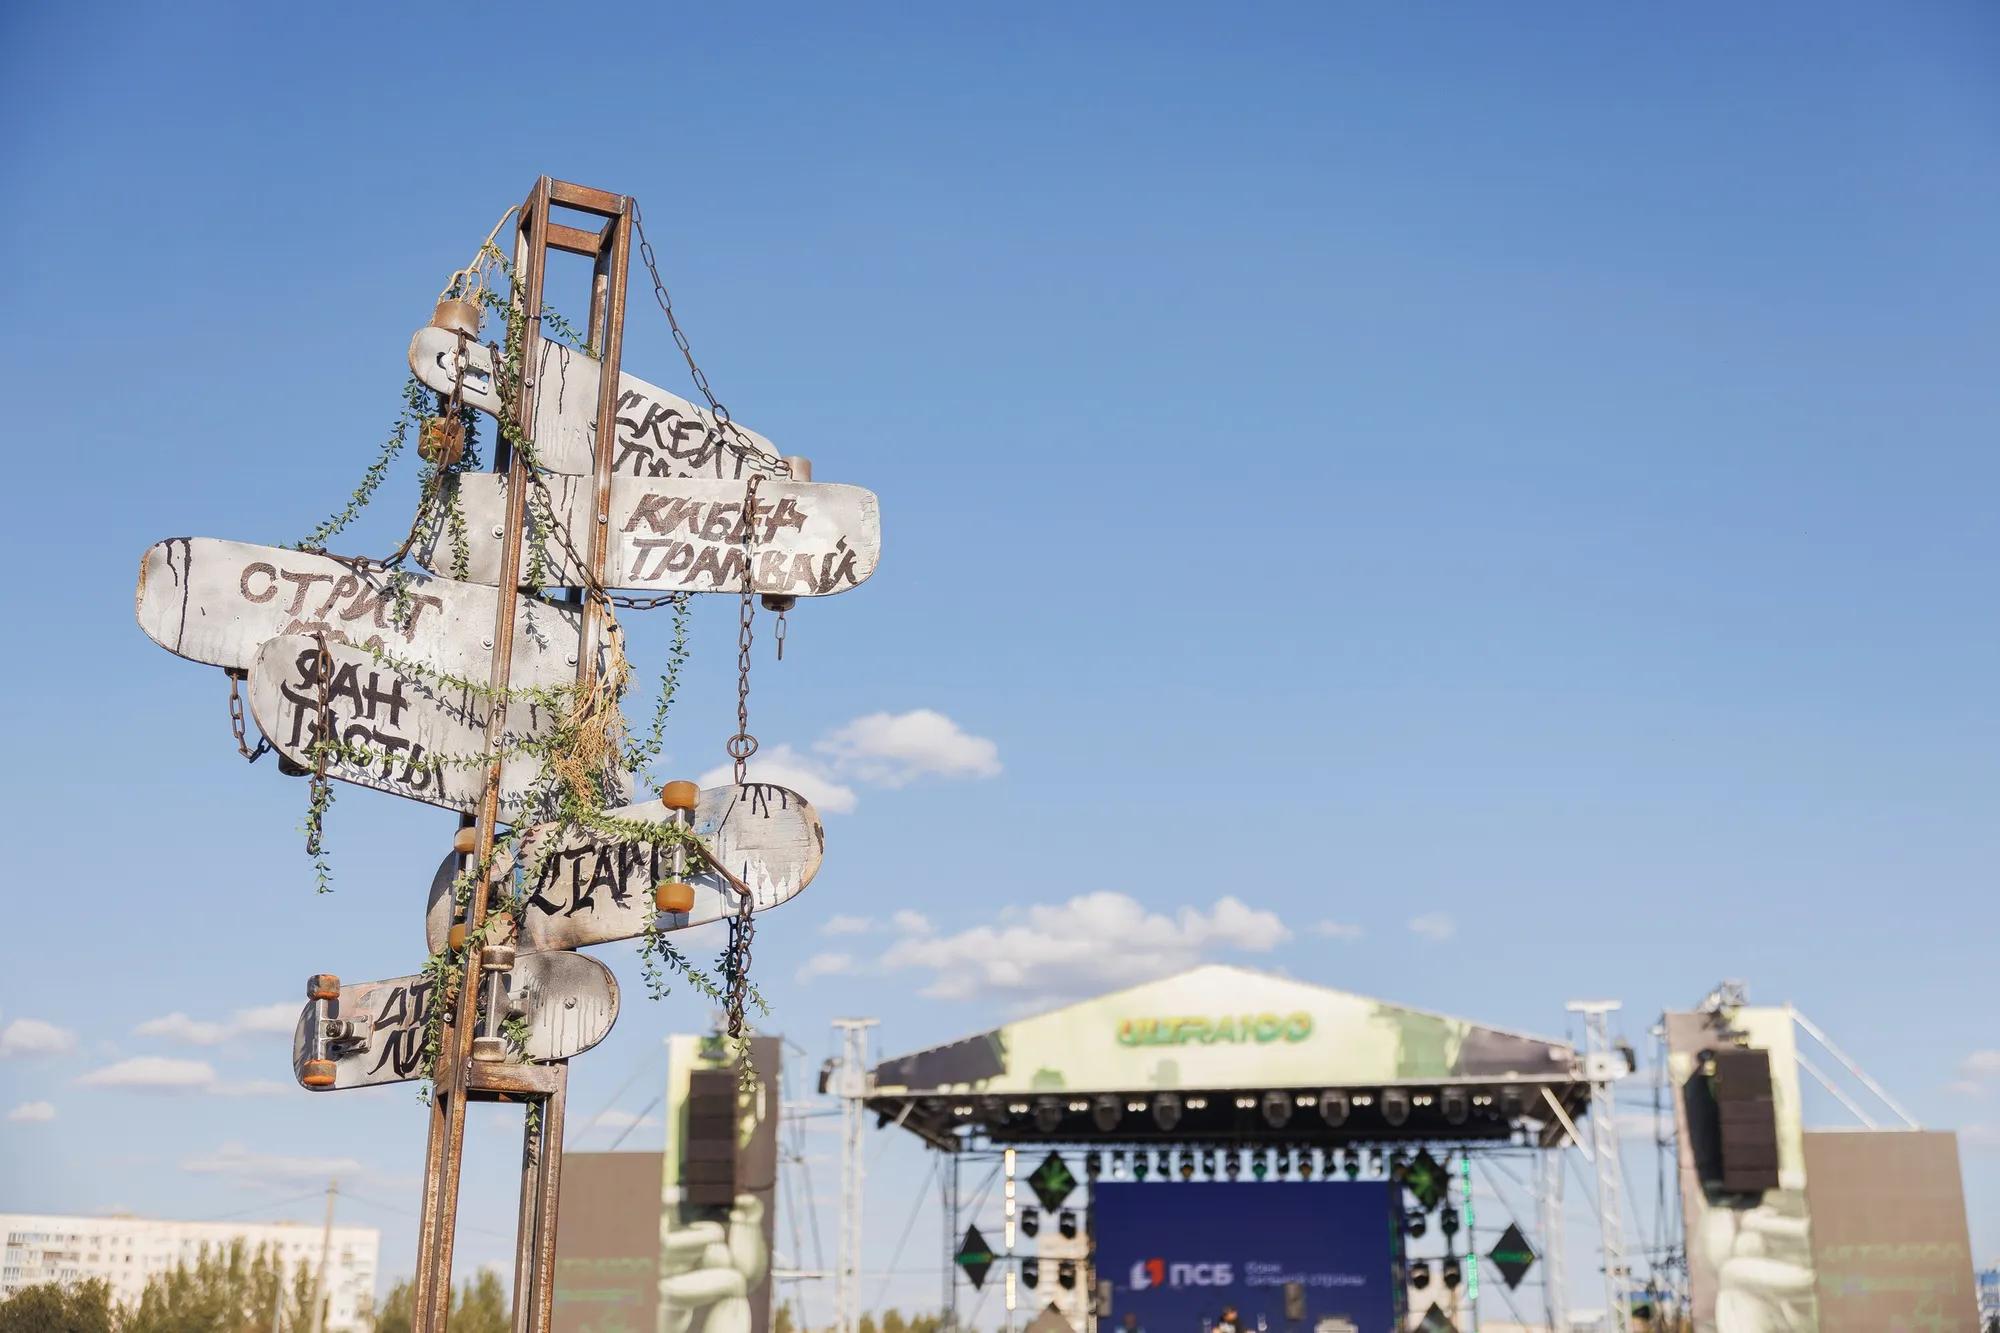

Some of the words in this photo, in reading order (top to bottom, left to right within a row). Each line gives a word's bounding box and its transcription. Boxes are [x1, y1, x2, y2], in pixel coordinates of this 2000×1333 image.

[621, 493, 808, 545] КИБЕР
[628, 534, 858, 594] ТРАМВАЙ
[240, 562, 443, 644] СТРИТ
[293, 648, 408, 730] ФАН
[1169, 1261, 1234, 1287] ПСБ
